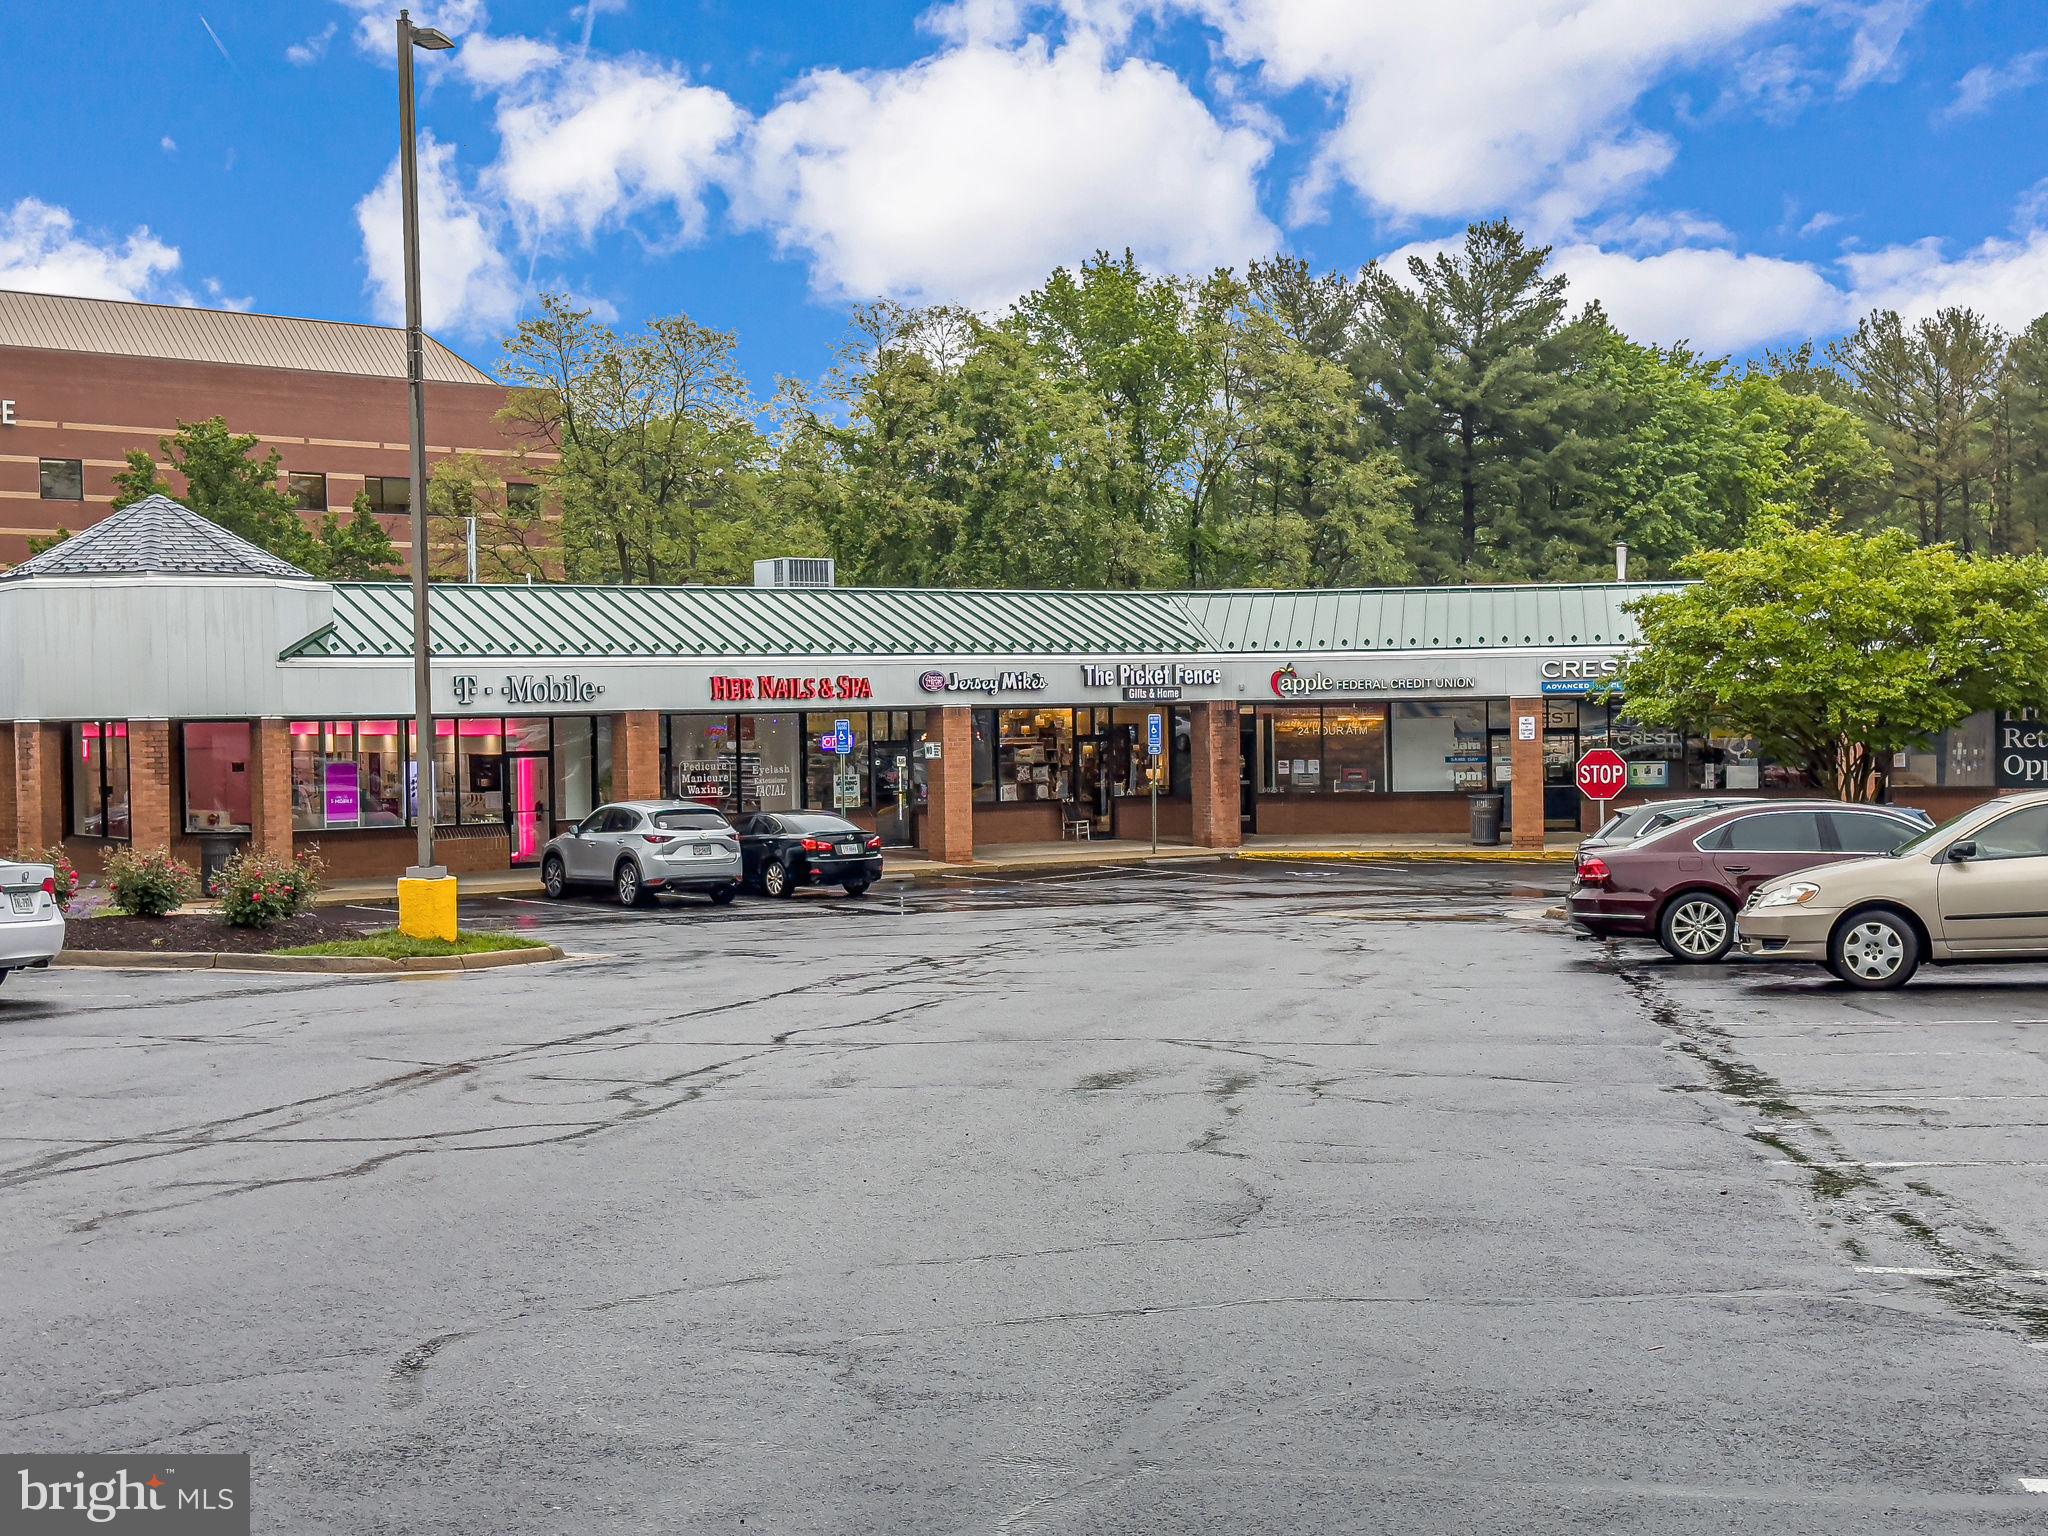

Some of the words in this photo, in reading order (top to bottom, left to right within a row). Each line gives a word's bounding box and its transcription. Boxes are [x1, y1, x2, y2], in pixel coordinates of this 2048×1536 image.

[1083, 664, 1114, 686] The
[1118, 664, 1169, 686] Picket
[1174, 664, 1221, 684] Fence
[709, 675, 755, 701] HER
[757, 675, 816, 701] NAILS
[818, 677, 835, 700] &
[836, 675, 874, 701] SPA
[947, 672, 1000, 695] Jersey
[1000, 671, 1049, 690] Mike's
[1280, 672, 1333, 695] apple
[1336, 680, 1388, 690] FEDERAL
[1390, 678, 1433, 689] CREDIT
[1435, 677, 1476, 688] UNION
[1128, 687, 1147, 699] Gifts
[1148, 688, 1156, 699] &
[1157, 687, 1179, 699] Home
[1297, 726, 1310, 736] 24
[1312, 726, 1344, 736] HOUR
[1345, 726, 1368, 736] ATM
[1617, 732, 1679, 746] CREST
[683, 762, 727, 772] Pedicure
[752, 764, 791, 776] Eyelash
[681, 774, 729, 783] Manicure
[1580, 765, 1623, 785] STOP
[687, 785, 724, 796] Waxing
[755, 784, 786, 797] FACIAL
